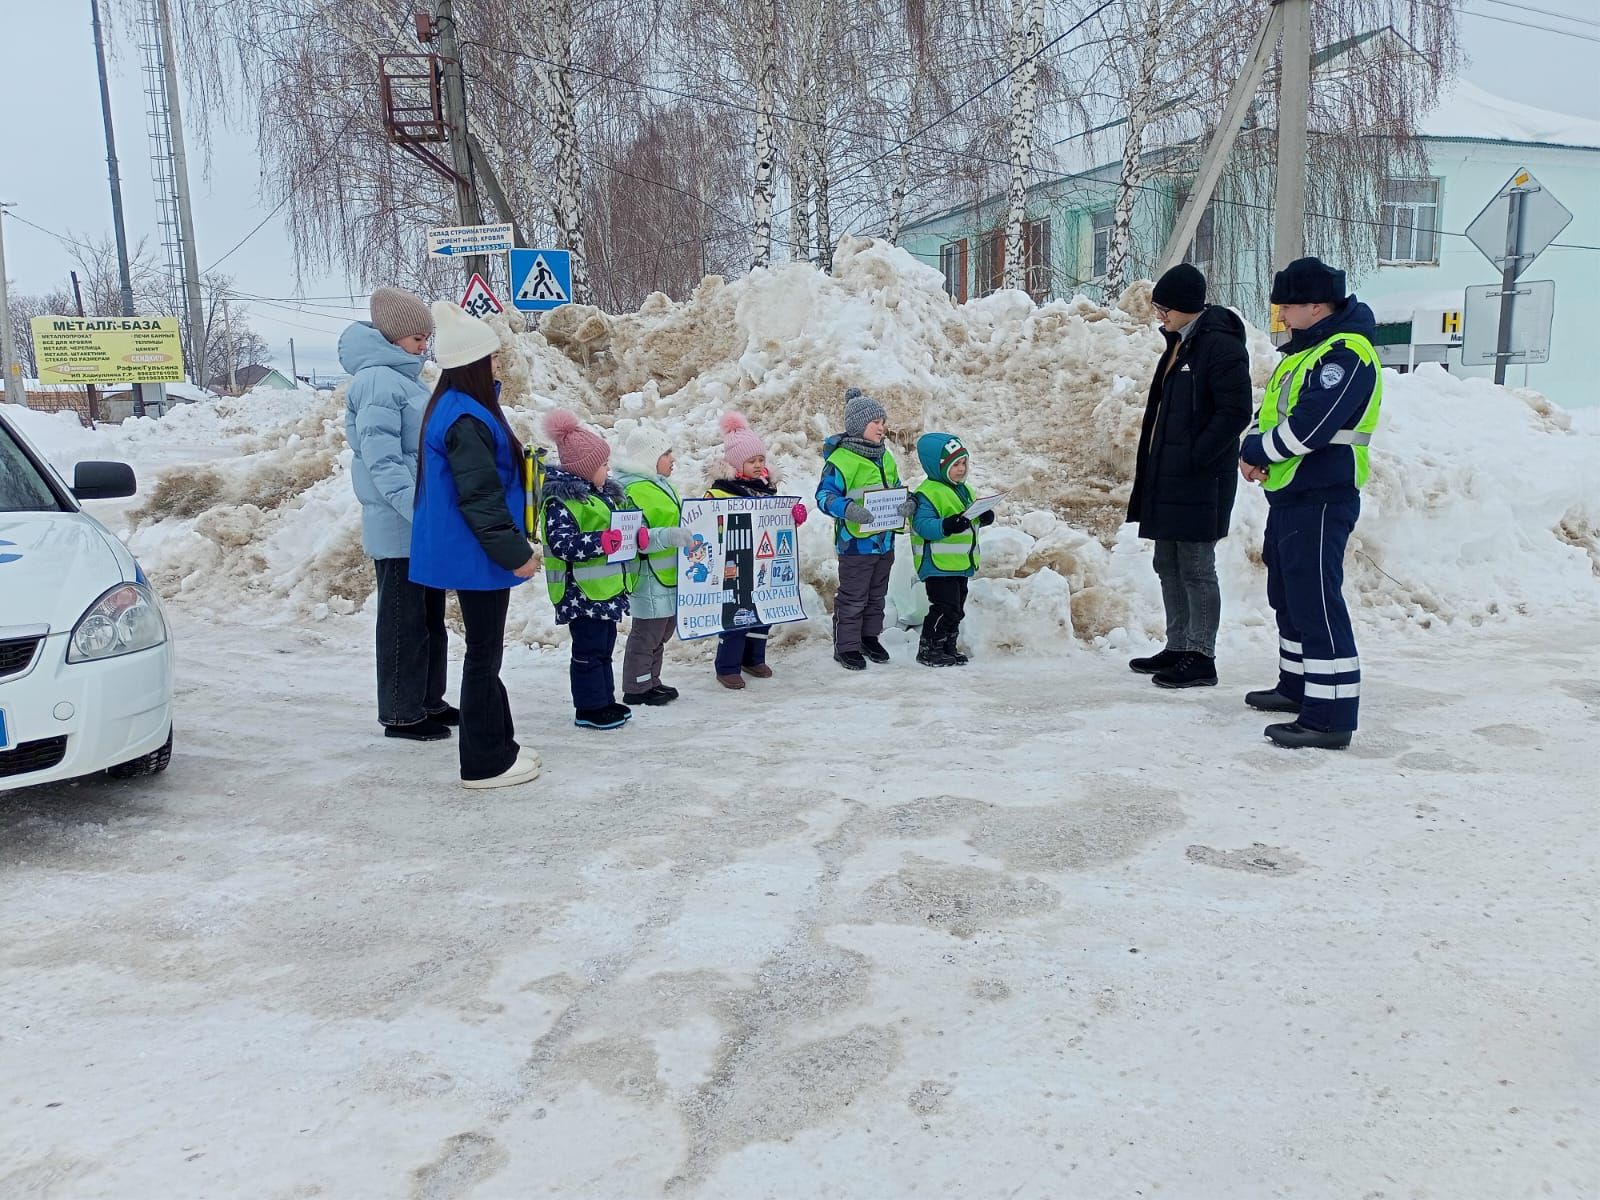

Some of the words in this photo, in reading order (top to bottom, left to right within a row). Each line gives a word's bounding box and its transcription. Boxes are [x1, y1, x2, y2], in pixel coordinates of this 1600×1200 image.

[436, 237, 461, 245] ЦЕМЕНТ
[481, 234, 505, 242] КРОВЛЯ
[53, 320, 162, 331] МЕТАЛЛ-БАЗА
[681, 505, 703, 527] МЫ
[711, 501, 721, 512] ЗА
[727, 498, 793, 511] БЕЗОПАСНЫЕ
[758, 514, 792, 529] ДОРОГИ
[773, 566, 781, 577] 02
[689, 614, 720, 628] ВСЕМ
[763, 604, 799, 620] ЖИЗНЬ!
